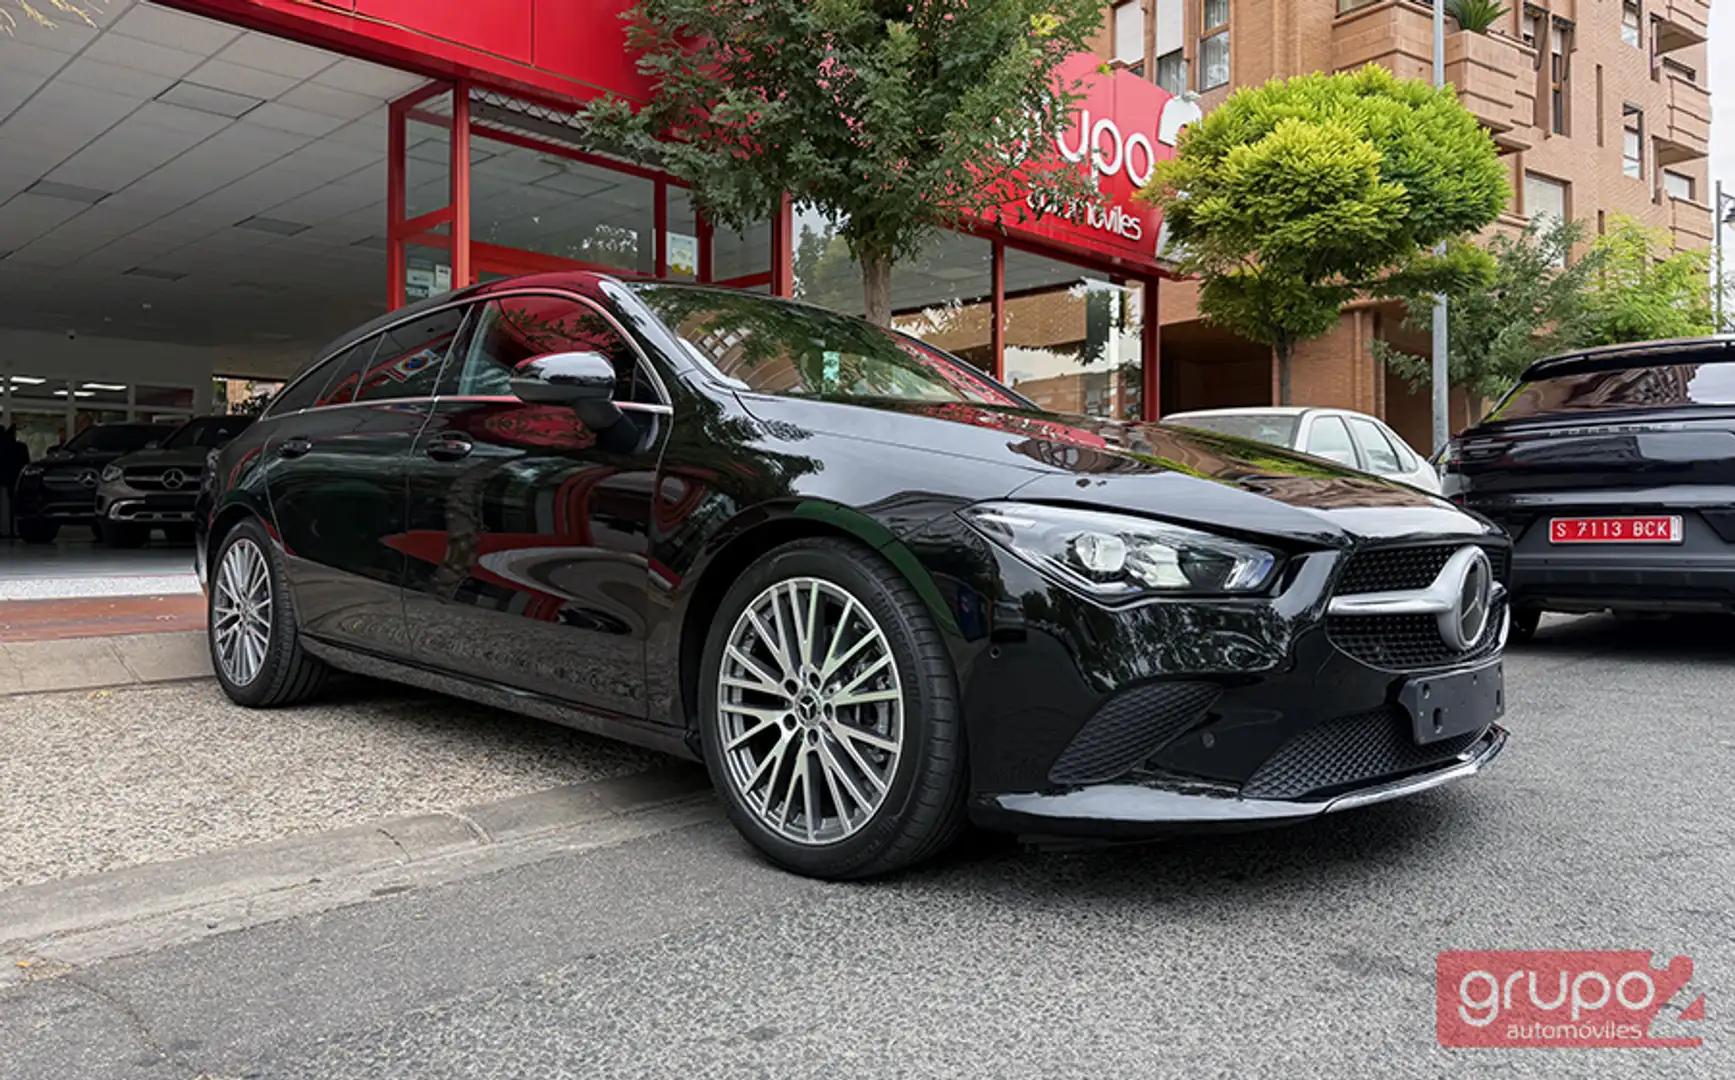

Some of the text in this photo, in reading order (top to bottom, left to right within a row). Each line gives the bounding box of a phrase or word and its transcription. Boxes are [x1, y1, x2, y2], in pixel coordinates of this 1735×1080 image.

[1556, 520, 1668, 537] S 7113 BCK
